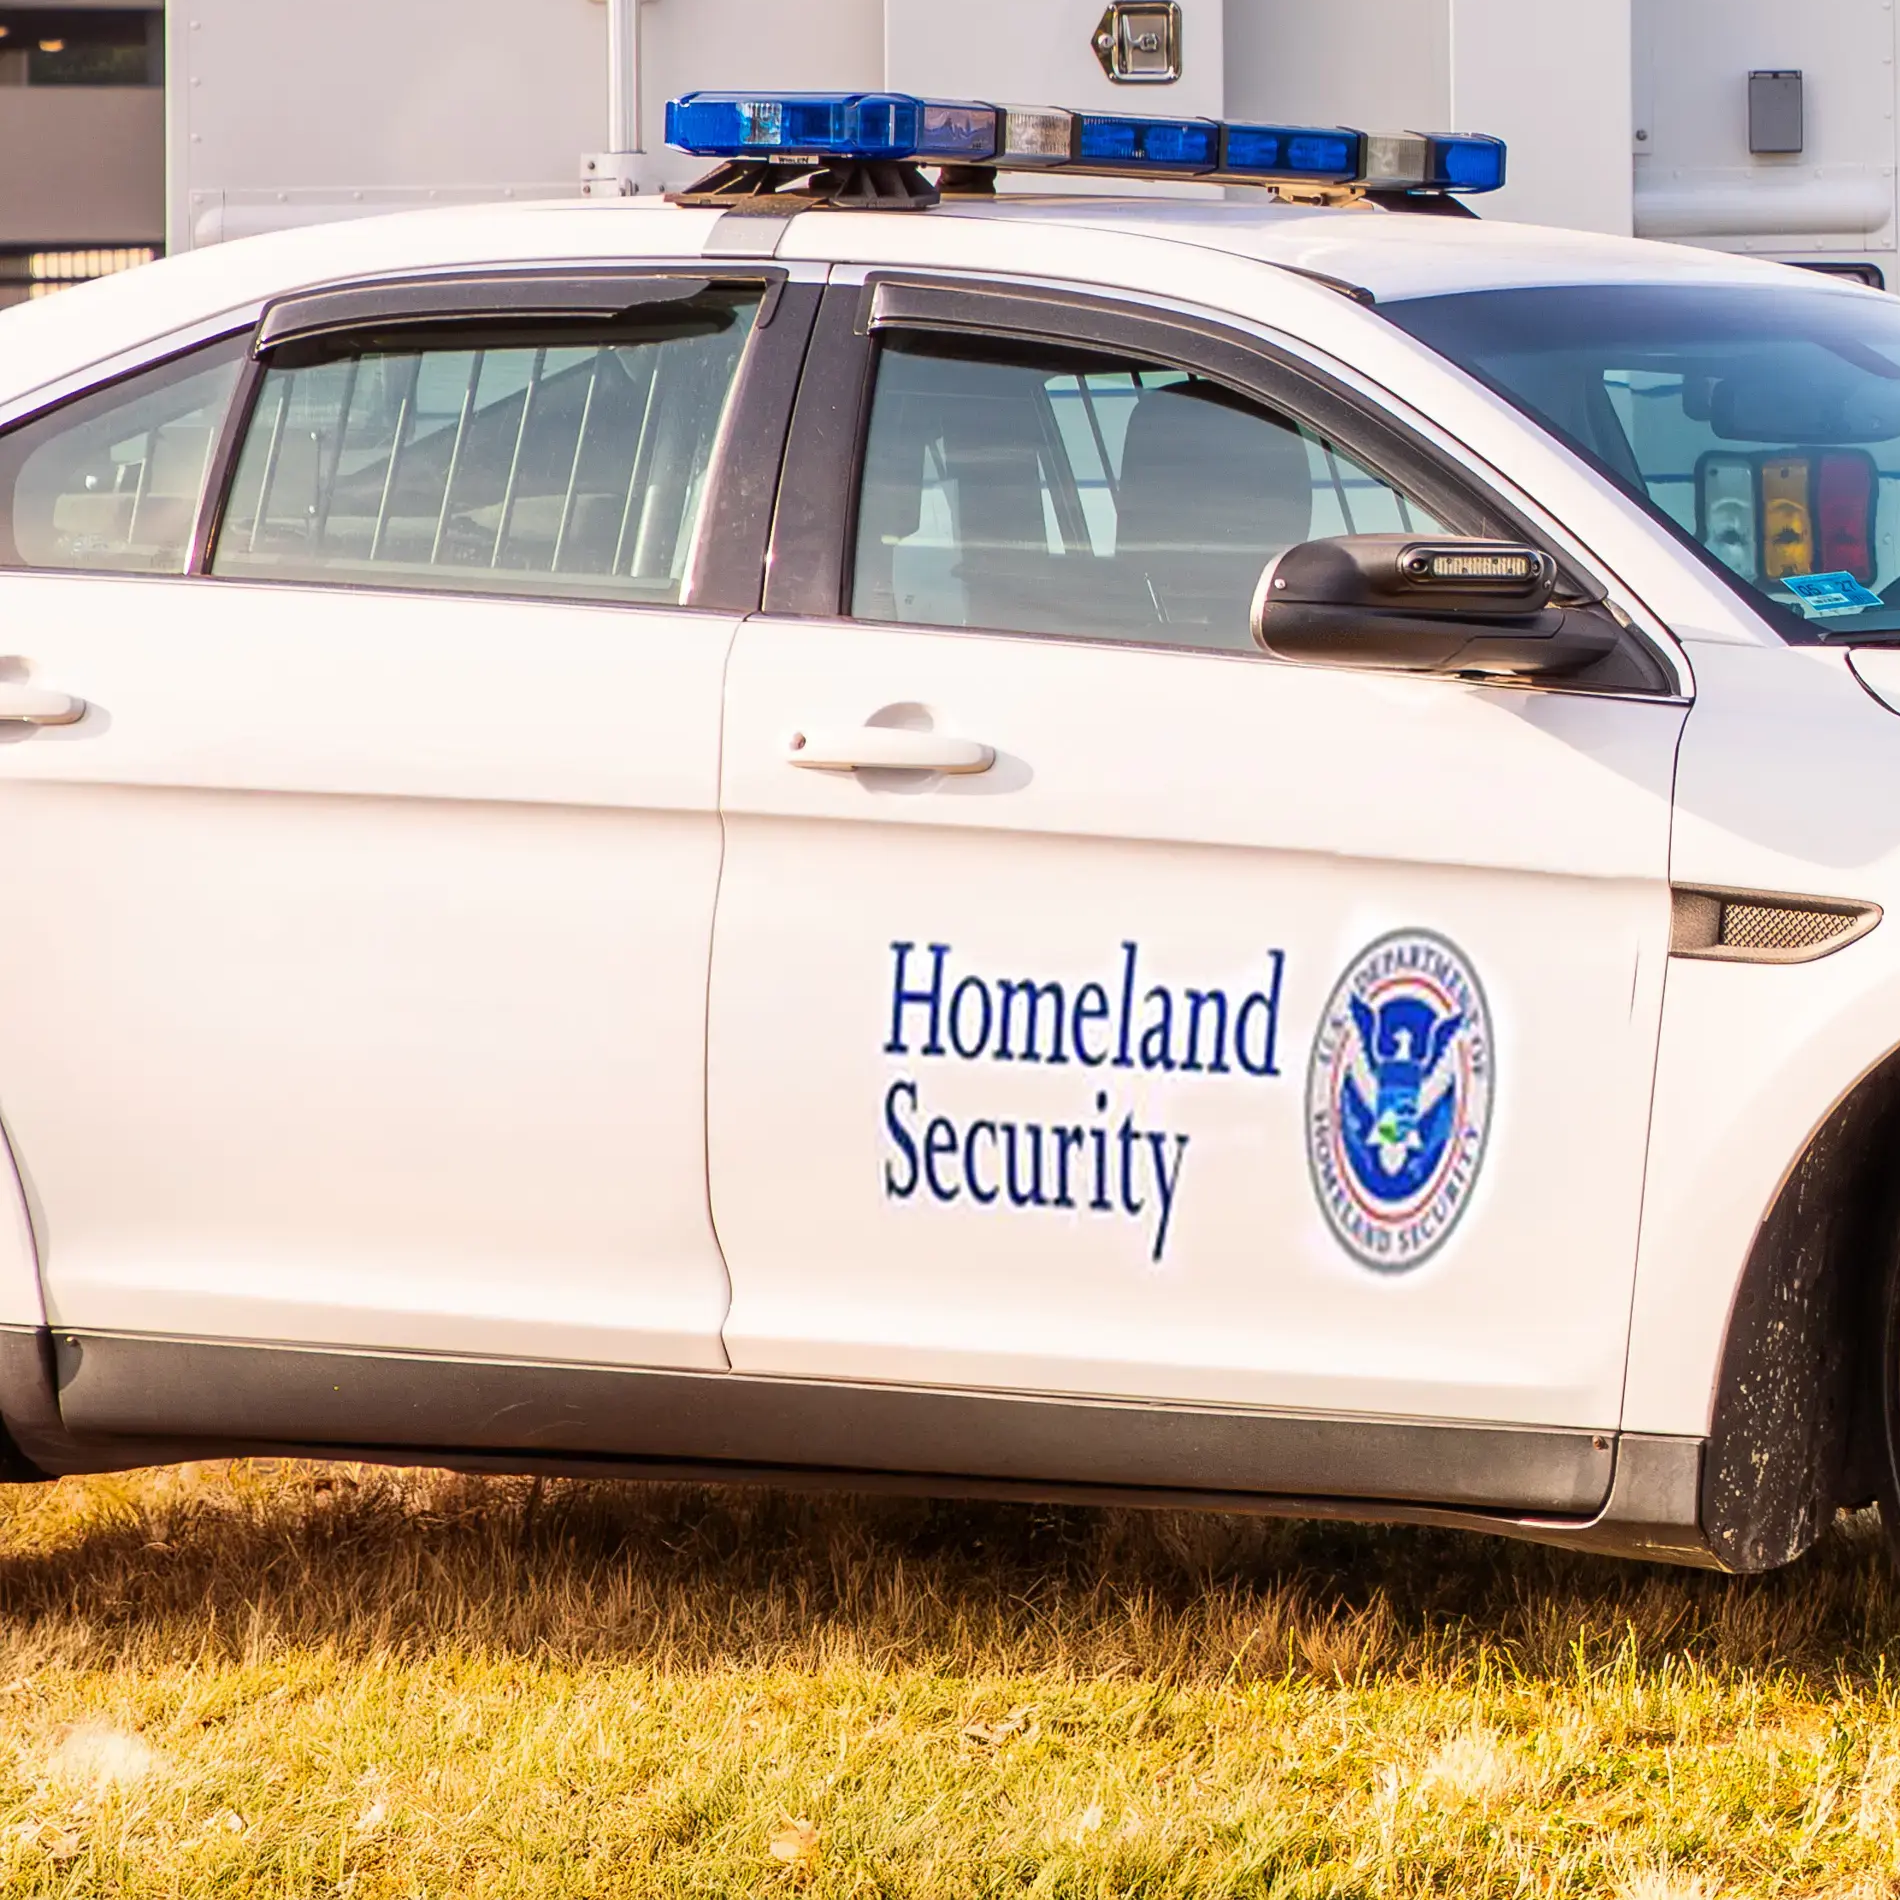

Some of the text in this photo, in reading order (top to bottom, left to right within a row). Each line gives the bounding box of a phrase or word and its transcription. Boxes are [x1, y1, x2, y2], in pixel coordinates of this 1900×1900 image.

[884, 941, 1285, 1076] Homeland
[1354, 946, 1480, 1026] DEPARTMENT
[885, 1080, 1189, 1262] Security
[1314, 1107, 1478, 1250] HOMELAND SECURITY
